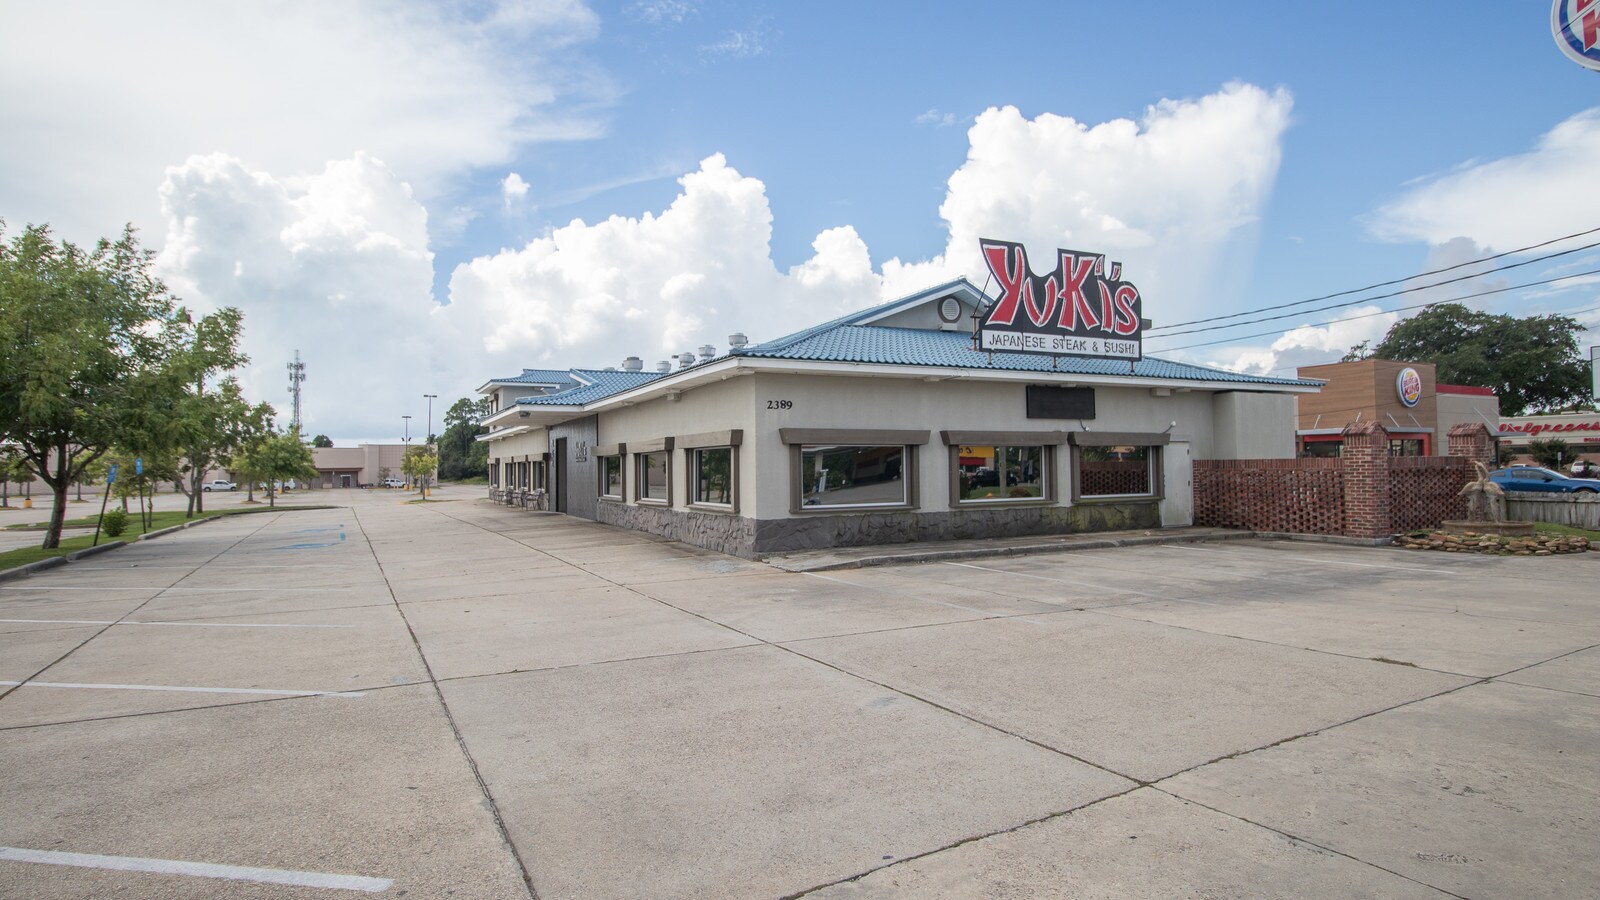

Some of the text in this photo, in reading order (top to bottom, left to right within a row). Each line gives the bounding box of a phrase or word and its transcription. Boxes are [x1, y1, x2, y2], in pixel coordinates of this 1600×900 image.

[989, 334, 1135, 355] JAPANESE STEAK & SUSHI
[766, 400, 793, 410] 2389
